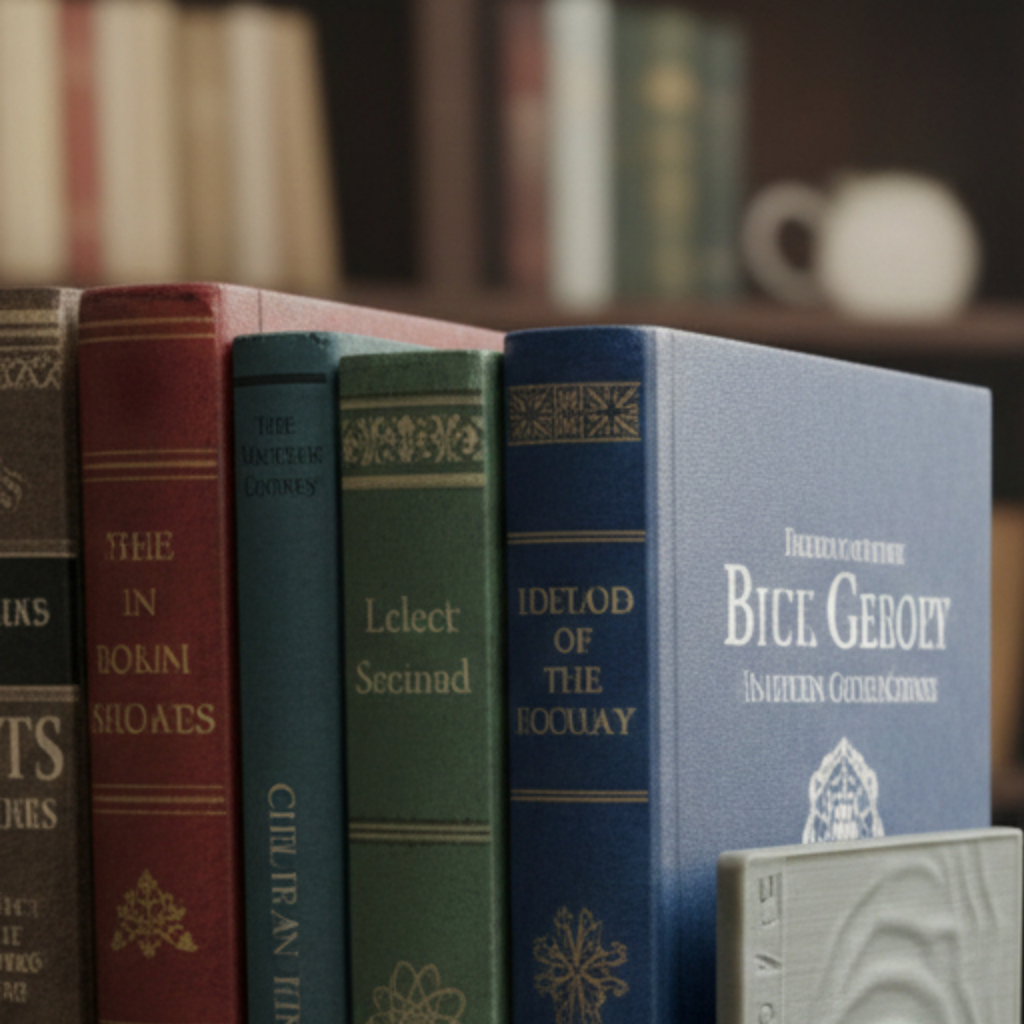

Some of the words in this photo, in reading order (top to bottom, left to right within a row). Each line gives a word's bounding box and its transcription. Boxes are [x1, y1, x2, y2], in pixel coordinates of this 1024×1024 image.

[123, 588, 156, 617] IN
[553, 627, 593, 654] OF
[543, 666, 603, 694] THE
